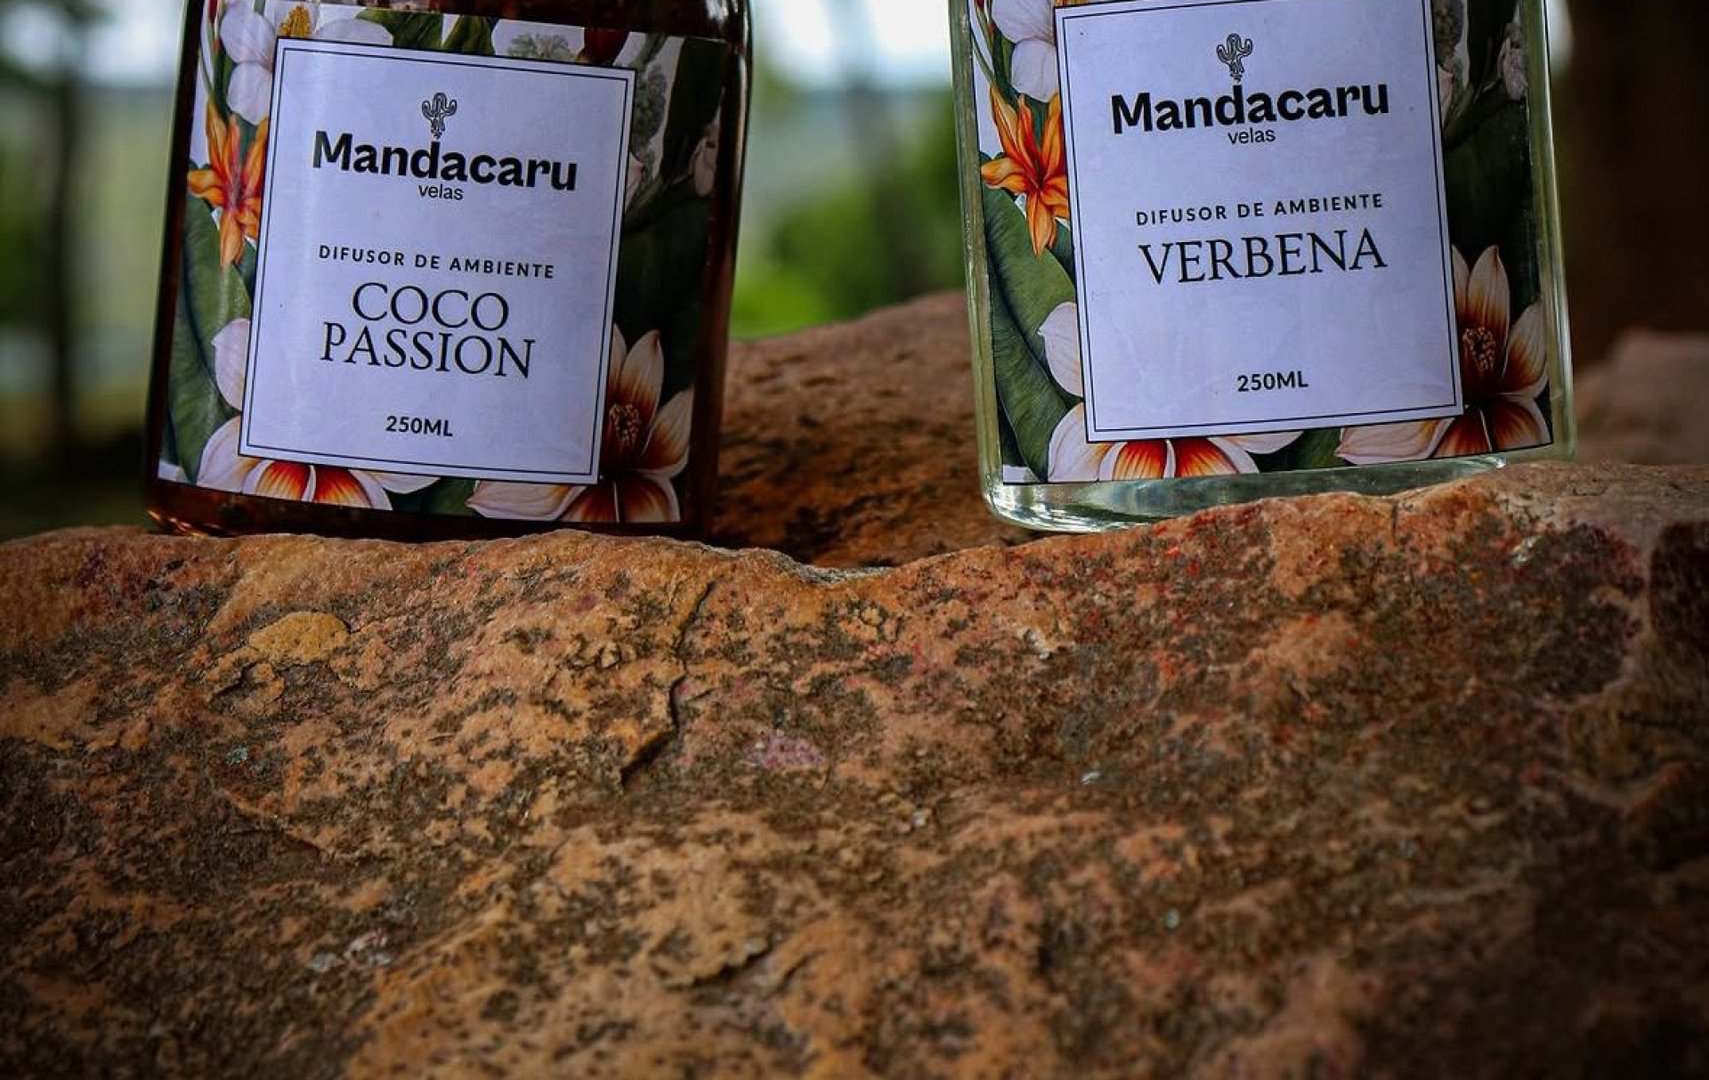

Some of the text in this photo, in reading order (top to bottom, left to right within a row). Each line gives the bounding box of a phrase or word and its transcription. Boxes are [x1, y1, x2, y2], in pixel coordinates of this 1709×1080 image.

[1111, 83, 1390, 135] Mandacaru
[1227, 127, 1276, 145] velas
[313, 130, 578, 192] Mandacaru
[418, 183, 464, 201] velas
[1136, 193, 1383, 226] DIFUSOR DE AMBIENTE
[319, 245, 554, 279] DIFUSOR DE AMBIENTE
[1138, 228, 1388, 284] VERBENA
[352, 281, 509, 331] COCO
[320, 321, 535, 378] PASSION
[1237, 370, 1308, 393] 250ML
[385, 415, 453, 437] 250ML
